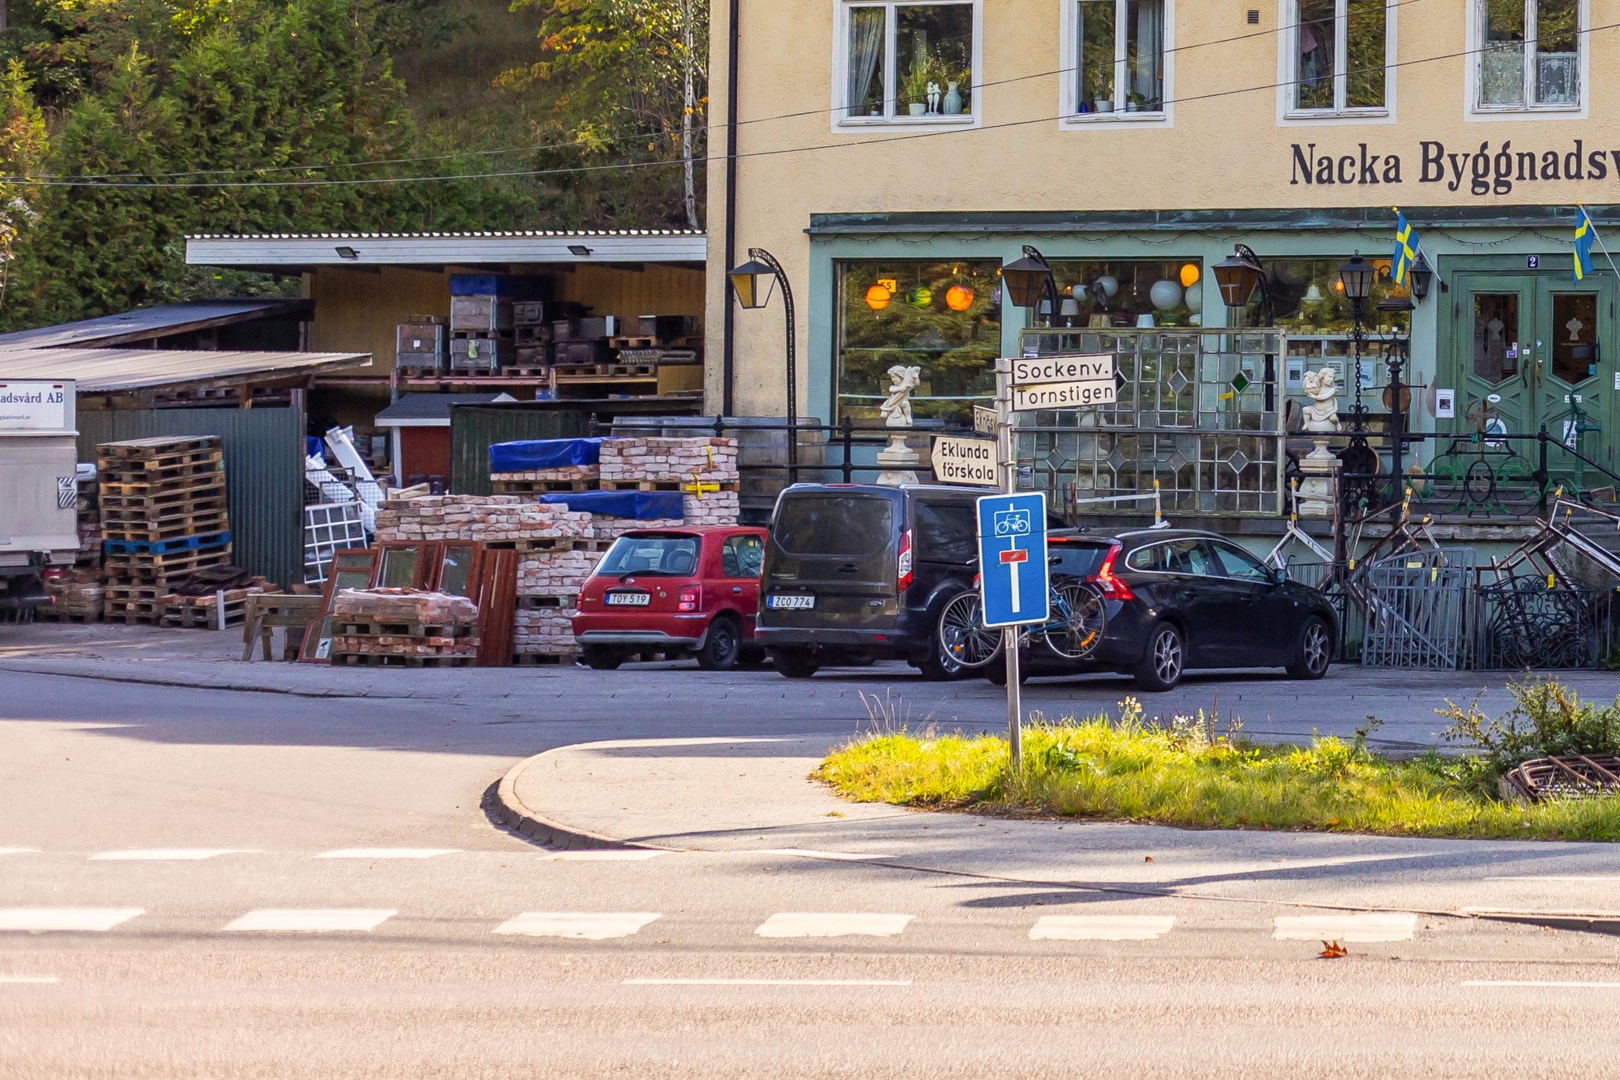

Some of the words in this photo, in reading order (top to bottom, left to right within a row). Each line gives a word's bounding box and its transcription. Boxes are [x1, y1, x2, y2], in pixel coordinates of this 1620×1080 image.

[1290, 143, 1402, 185] Nacka
[1529, 256, 1536, 267] 2
[1017, 361, 1109, 379] Sockenv.
[46, 392, 64, 404] AB
[1017, 386, 1113, 406] Tornstigen
[941, 441, 989, 460] Eklunda
[943, 463, 994, 480] förskola
[612, 594, 628, 605] TOY
[629, 594, 647, 605] 519
[776, 596, 792, 607] ZCO
[794, 596, 809, 607] 774
